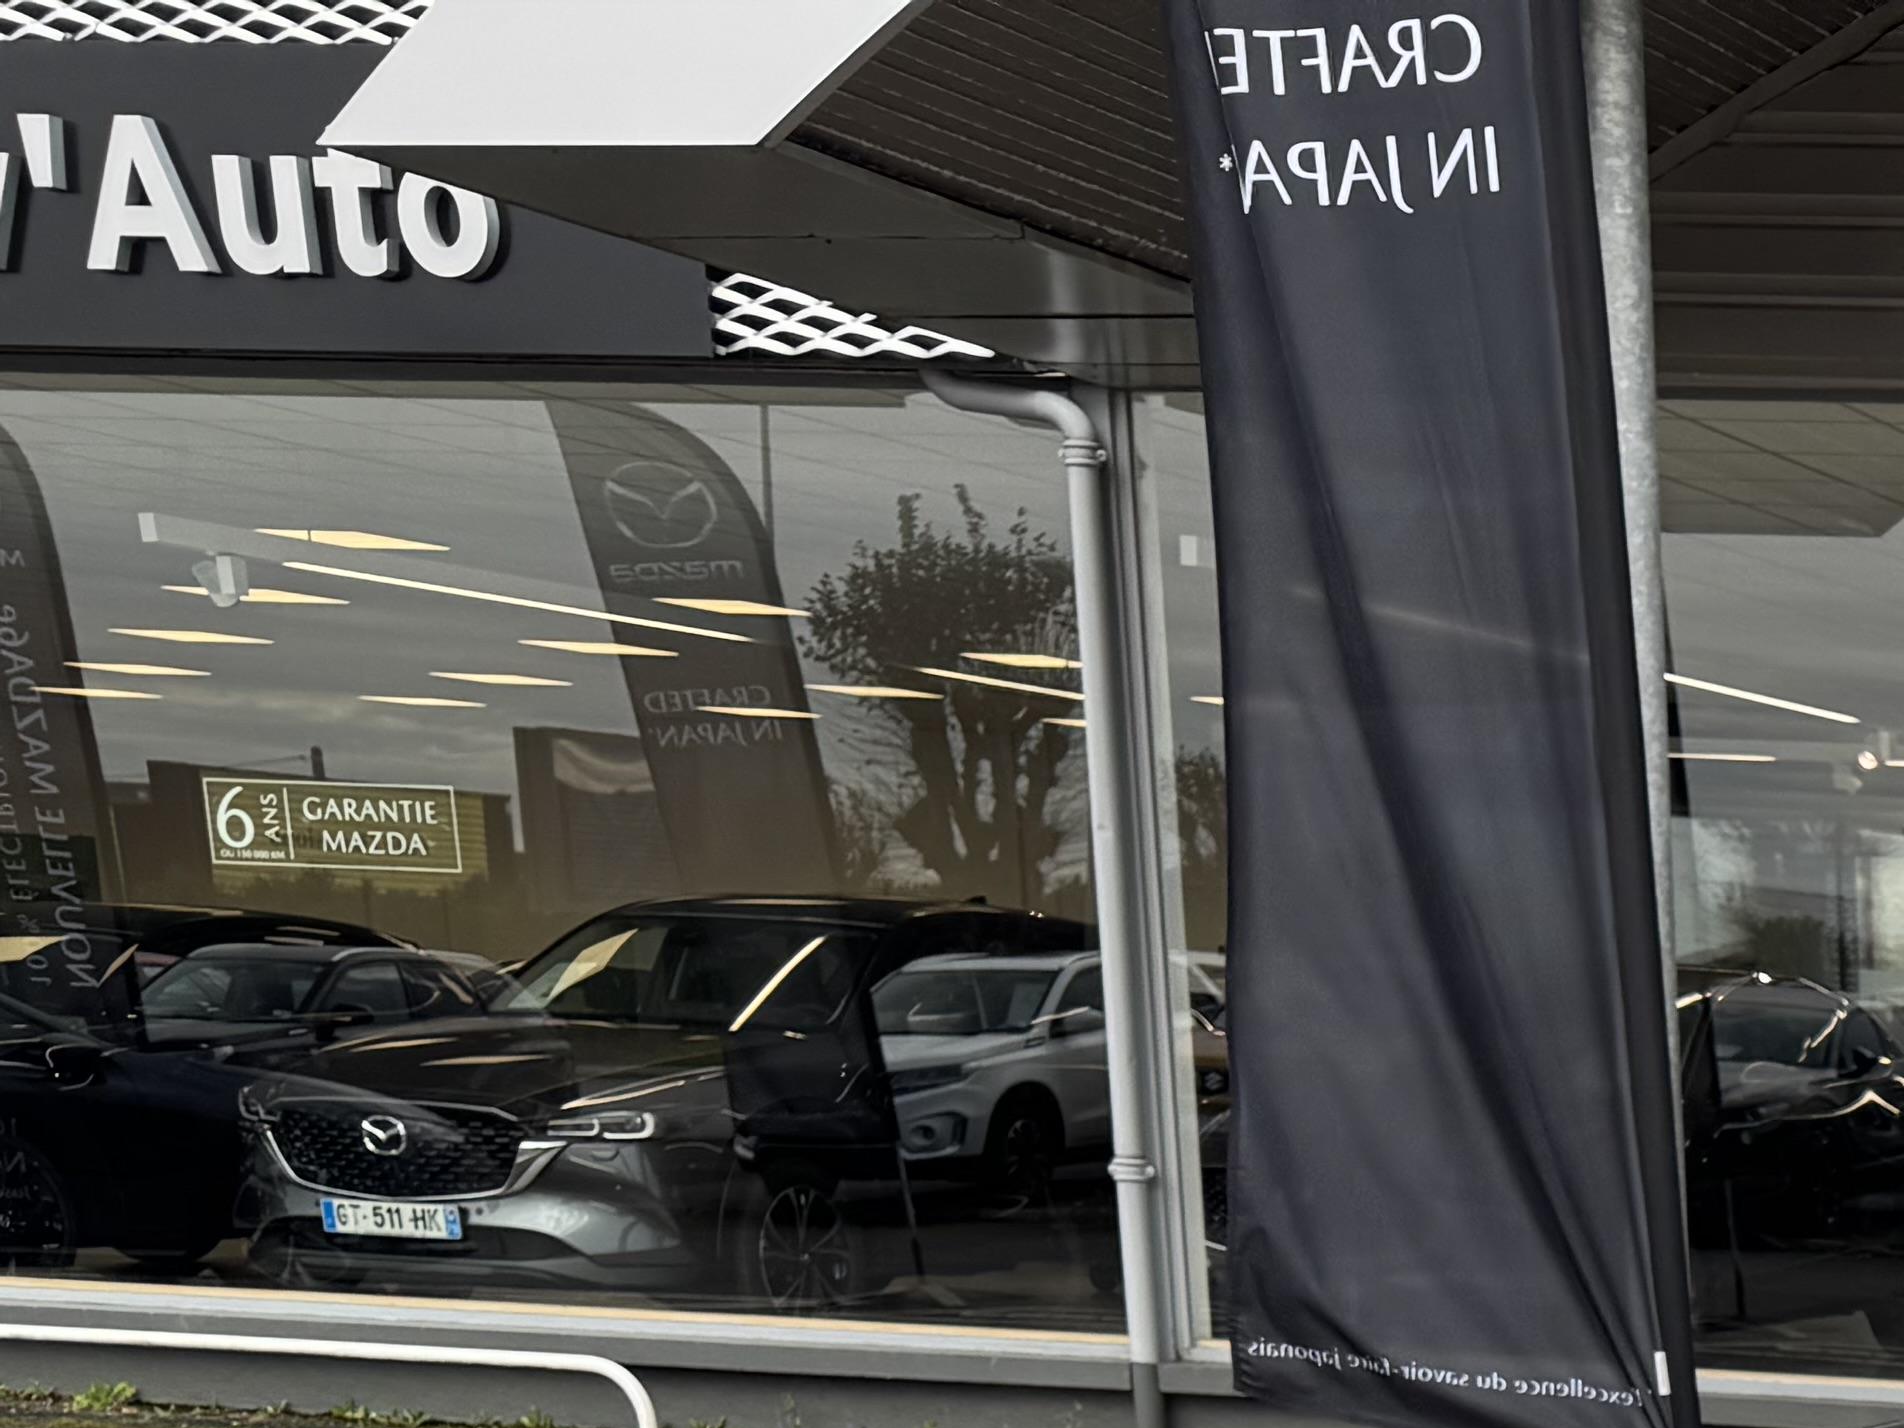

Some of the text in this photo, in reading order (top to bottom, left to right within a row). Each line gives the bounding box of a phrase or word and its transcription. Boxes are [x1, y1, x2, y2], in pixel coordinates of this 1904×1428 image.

[0, 113, 499, 278] 'Auto
[217, 786, 282, 848] 6 ANS
[302, 796, 439, 825] GARANTIE
[322, 830, 428, 856] MAZDA
